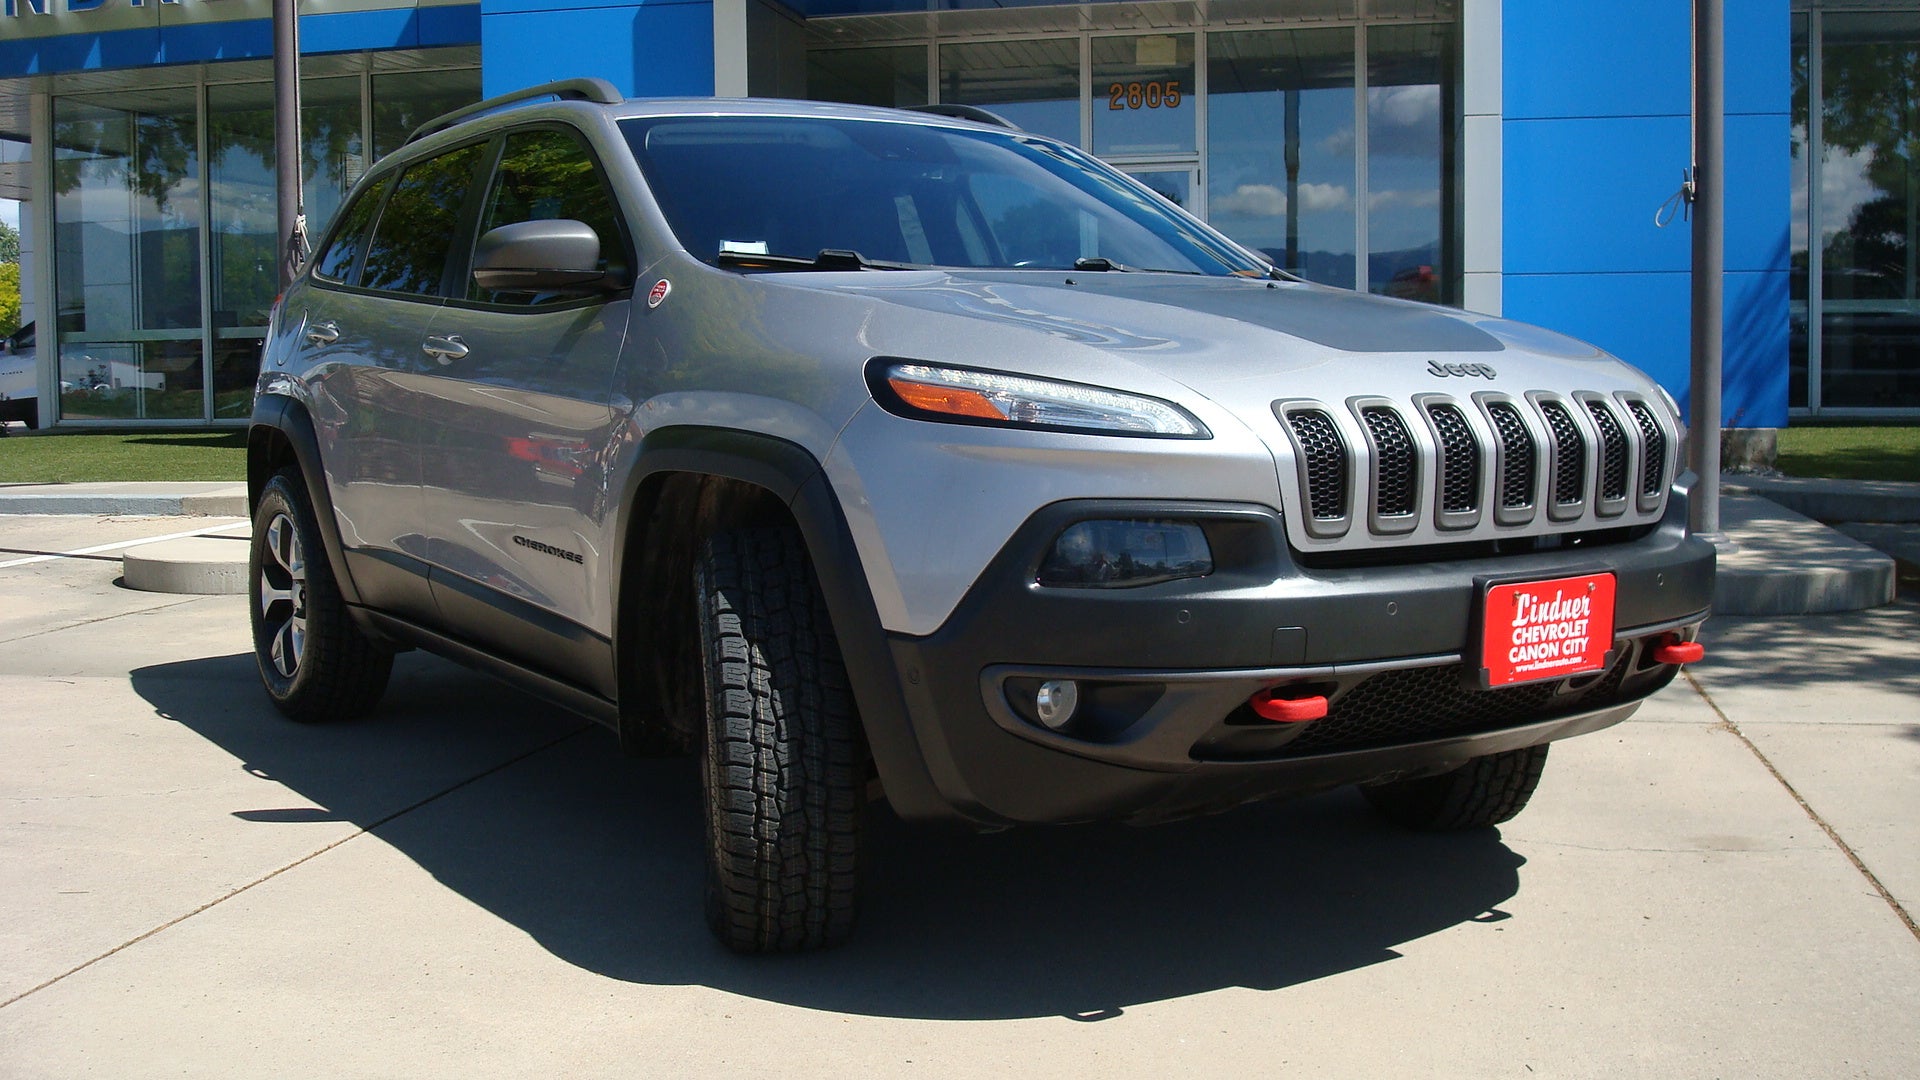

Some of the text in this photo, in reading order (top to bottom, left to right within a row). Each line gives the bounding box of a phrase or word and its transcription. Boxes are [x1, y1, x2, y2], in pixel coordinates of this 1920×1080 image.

[1109, 81, 1181, 110] 2805
[1427, 359, 1497, 380] Jeep
[513, 535, 584, 565] CHEROKEE
[1512, 589, 1591, 627] Lindner
[1512, 619, 1588, 645] CHEVROLET
[1508, 636, 1589, 663] CANON CITY
